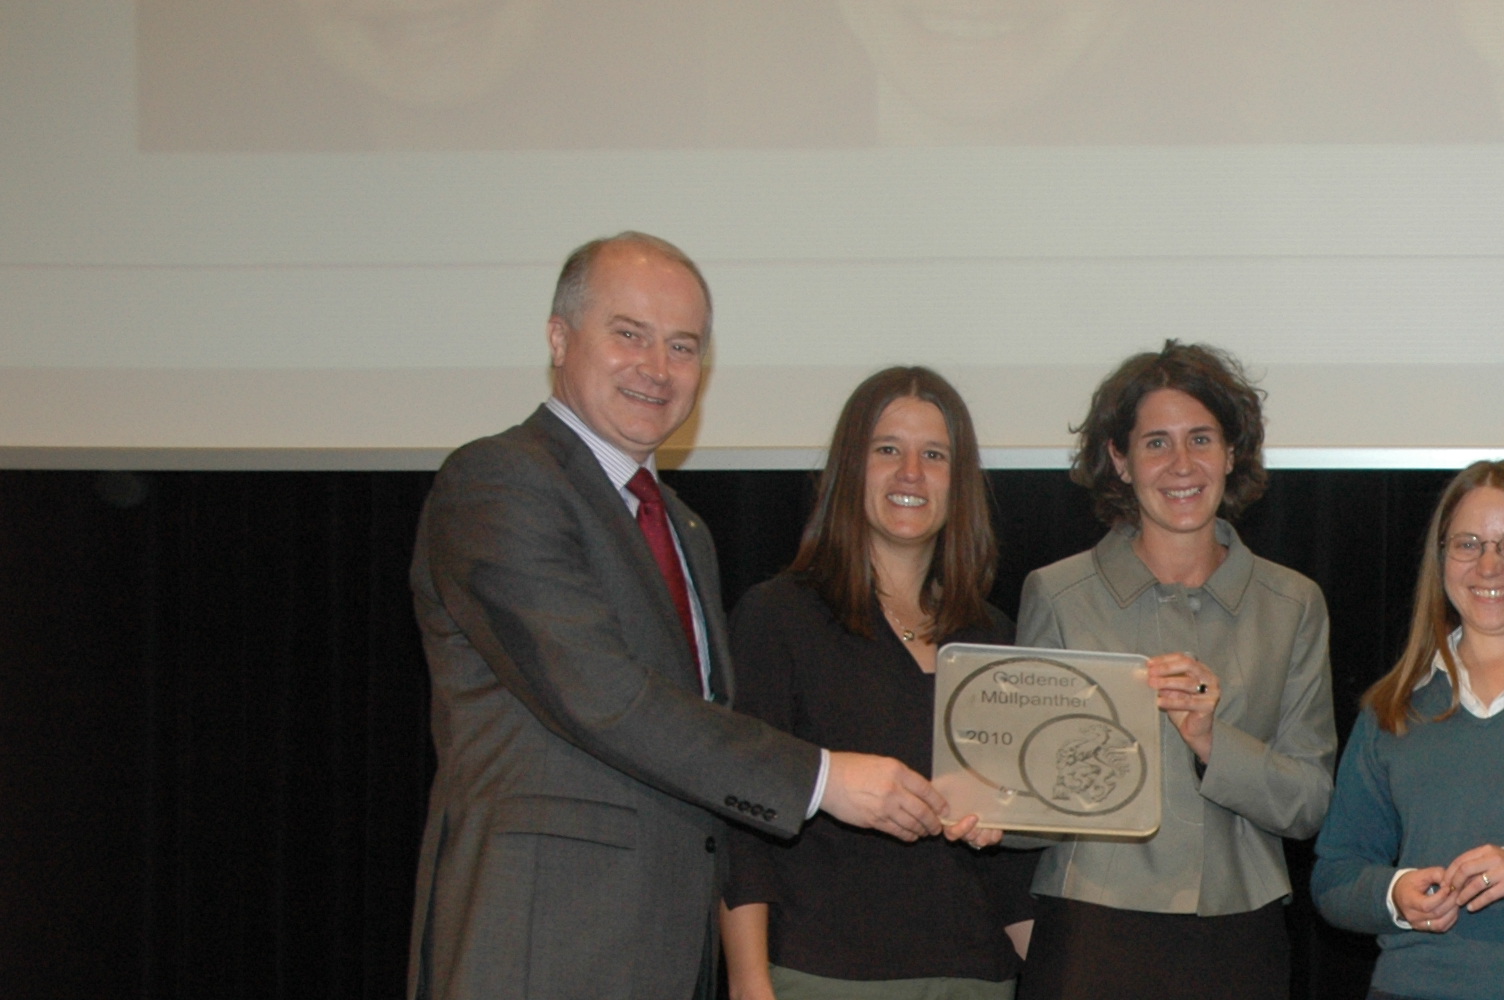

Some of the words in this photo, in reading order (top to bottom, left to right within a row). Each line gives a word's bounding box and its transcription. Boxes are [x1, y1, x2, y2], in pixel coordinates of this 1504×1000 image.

[993, 670, 1077, 687] Goldener
[981, 690, 1089, 708] Müllpanther
[966, 730, 1013, 746] 2010
